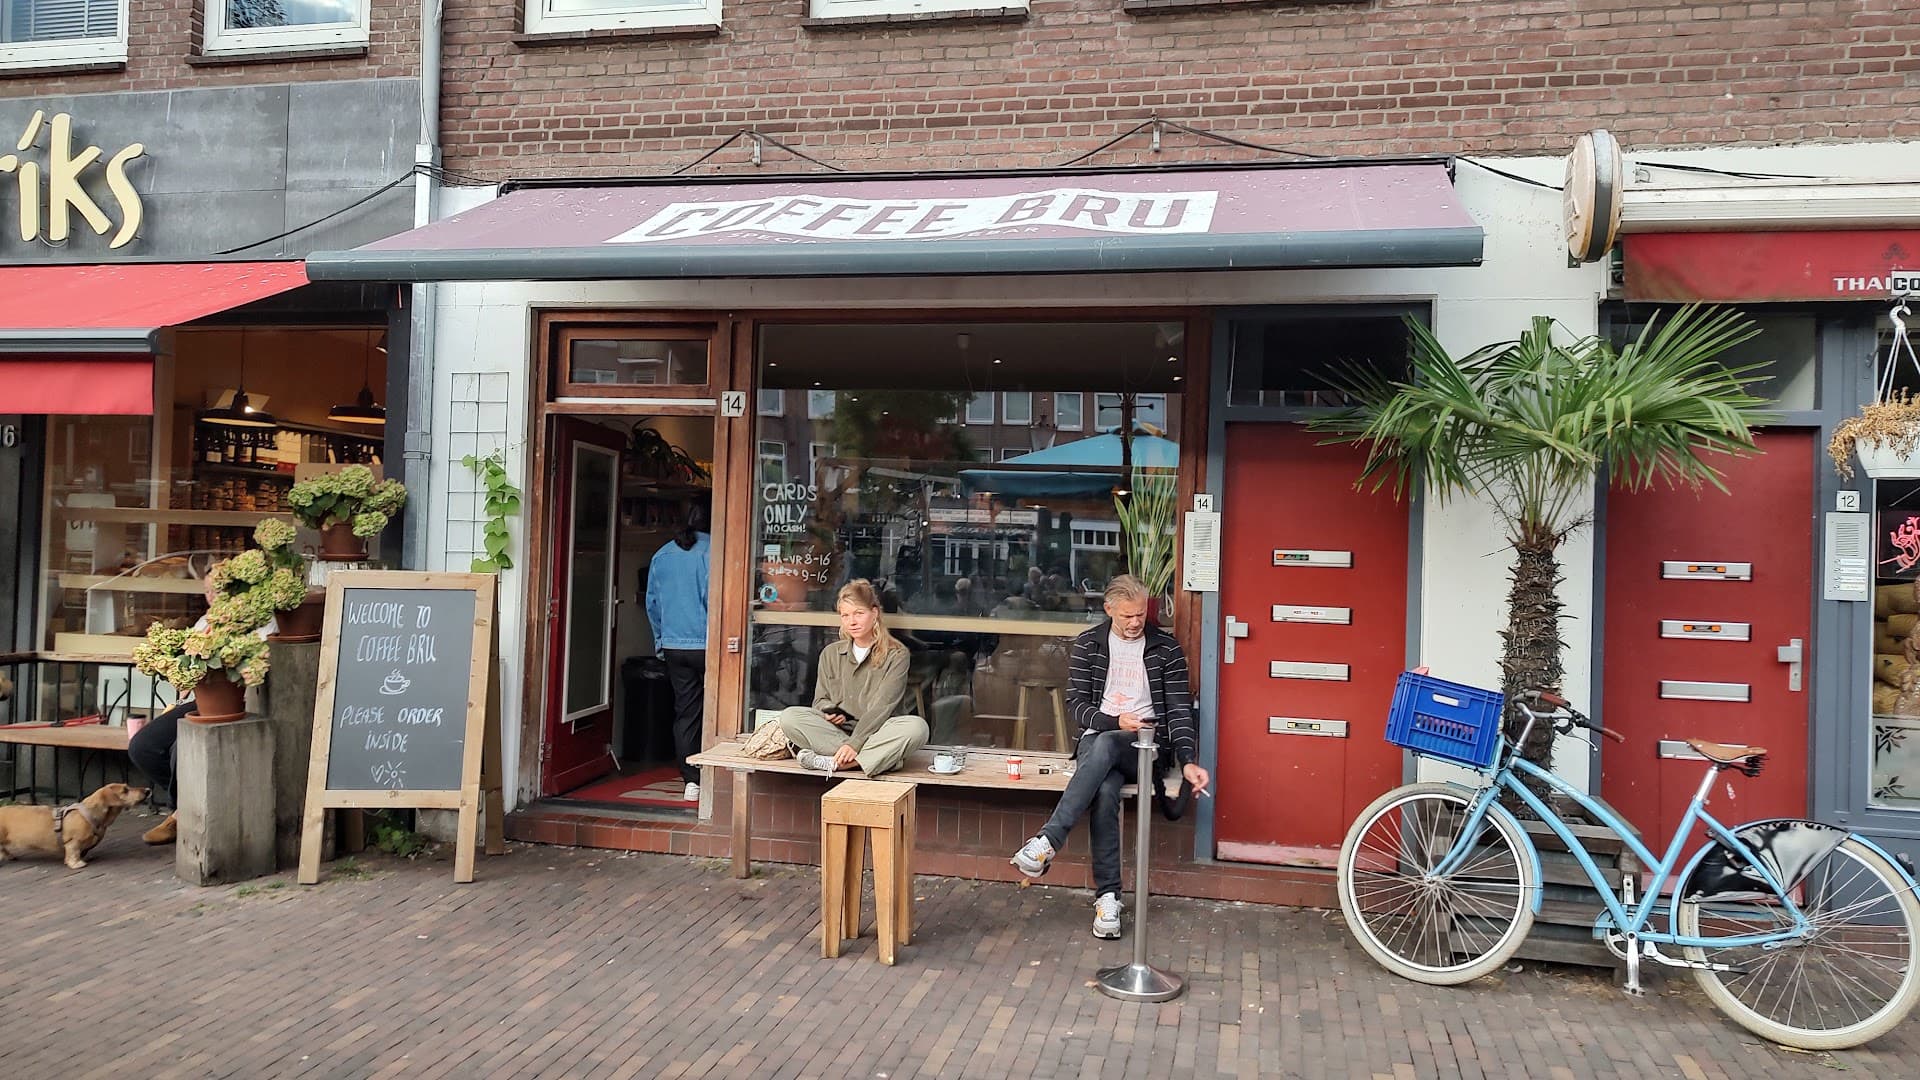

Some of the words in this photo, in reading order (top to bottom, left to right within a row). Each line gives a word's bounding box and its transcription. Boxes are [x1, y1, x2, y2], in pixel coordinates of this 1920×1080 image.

[645, 199, 968, 236] COFFEE
[993, 194, 1188, 228] BRU
[724, 395, 742, 413] 14
[763, 483, 817, 502] CARDS
[1841, 495, 1855, 508] 12
[1197, 498, 1209, 509] 14
[764, 504, 808, 524] ONLY
[804, 552, 832, 566] 8-16
[801, 568, 829, 583] 9-16
[348, 601, 405, 628] WELCOME
[415, 605, 432, 629] TO
[357, 635, 402, 662] COFFEE
[406, 633, 437, 665] BRU
[339, 705, 385, 729] PLEASE
[397, 706, 444, 728] ORDER
